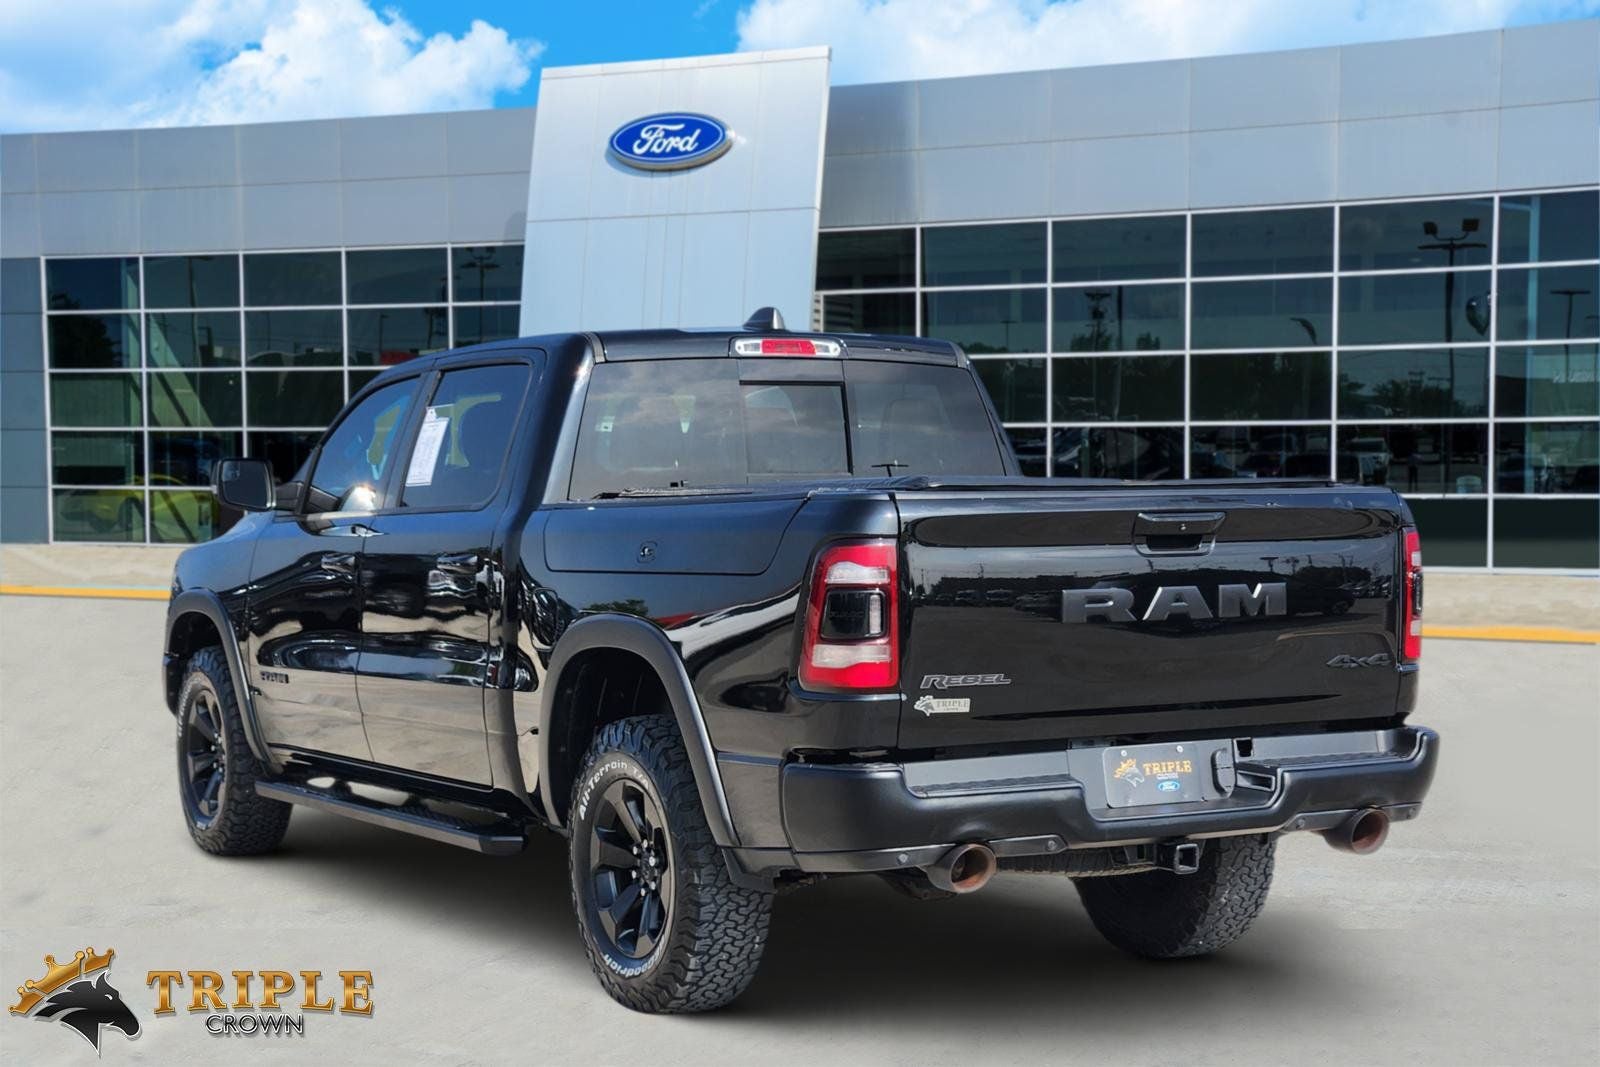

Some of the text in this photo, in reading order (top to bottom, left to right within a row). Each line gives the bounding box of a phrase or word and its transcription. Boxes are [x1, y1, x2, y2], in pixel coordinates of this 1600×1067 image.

[632, 123, 702, 155] Ford
[1062, 582, 1288, 624] RAM
[1142, 760, 1193, 776] TRIPLE
